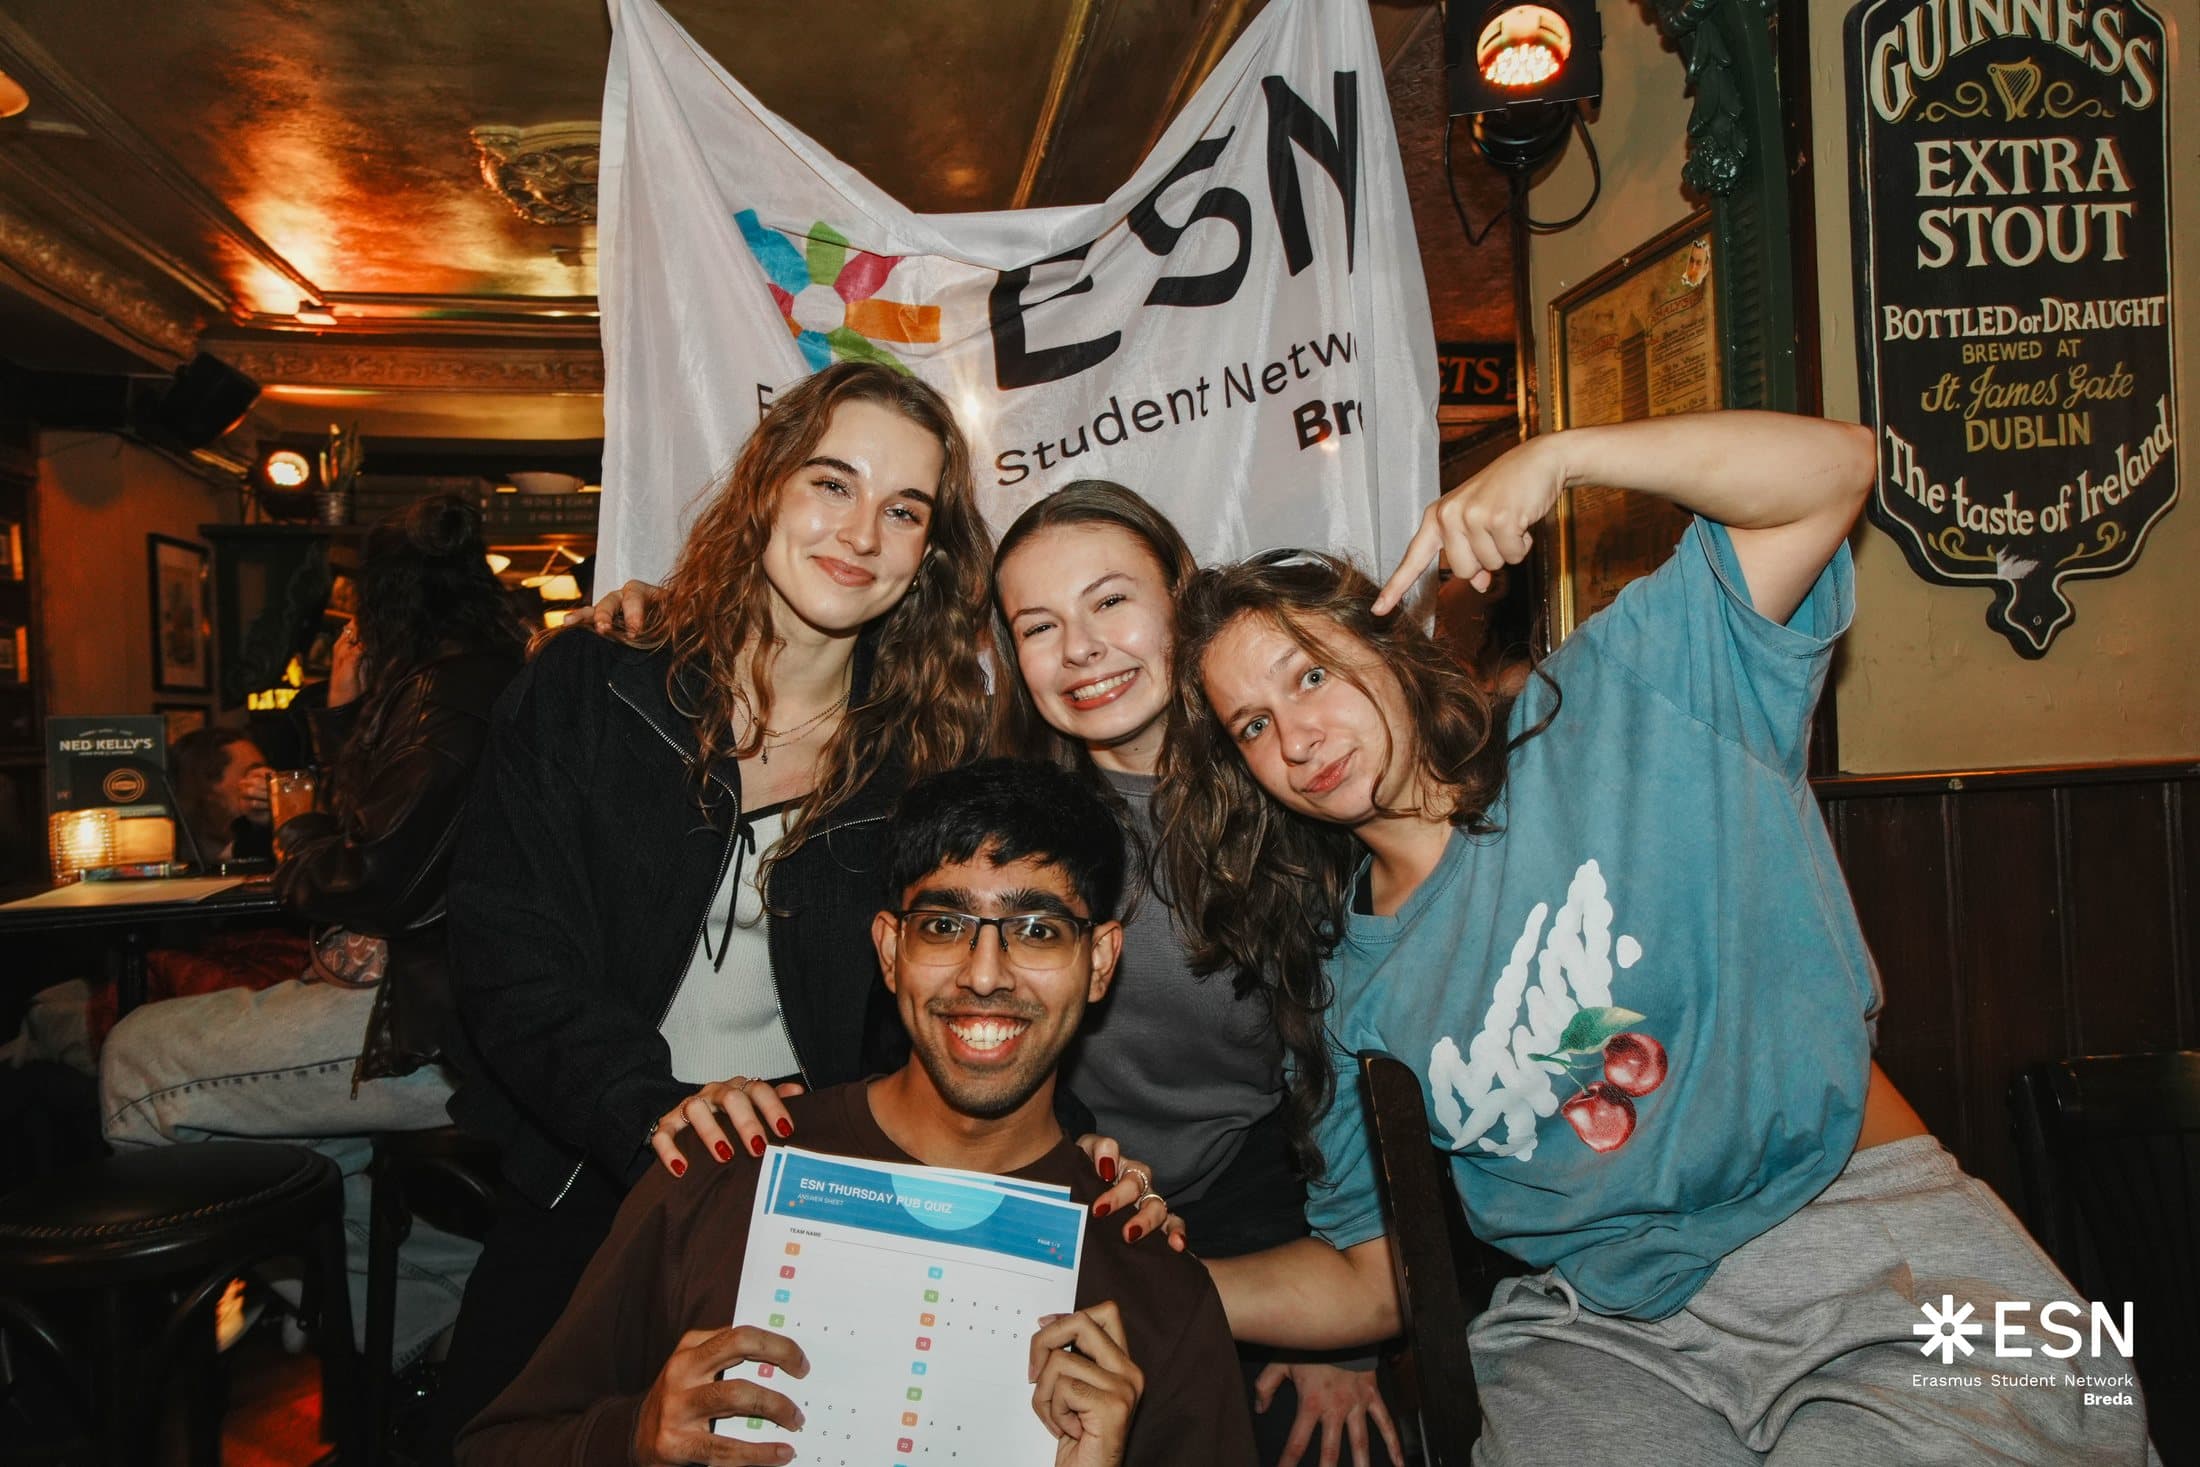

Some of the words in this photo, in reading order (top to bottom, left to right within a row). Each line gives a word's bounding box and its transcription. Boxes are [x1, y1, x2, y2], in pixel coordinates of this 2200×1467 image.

[1870, 0, 2155, 122] GUINNESS
[1914, 138, 2132, 197] EXTRA
[989, 70, 1359, 390] ESN
[1917, 203, 2132, 270] STOUT
[1883, 304, 2018, 341] BOTTLED
[2018, 313, 2043, 334] or
[2040, 296, 2166, 334] DRAUGHT
[1962, 341, 2043, 365] BREWED
[2056, 338, 2082, 359] AT
[996, 377, 1211, 487] Student
[1223, 332, 1359, 410] Netw
[1920, 371, 1961, 412] St.
[1963, 364, 2060, 420] James
[2063, 361, 2135, 409] Gate
[1293, 399, 1364, 451] Br
[1965, 412, 2093, 453] DUBLIN
[1885, 425, 1946, 515] The
[1951, 475, 2034, 536] taste
[2039, 484, 2072, 533] of
[2076, 393, 2173, 524] Ireland
[59, 740, 92, 752] NED
[96, 738, 153, 751] KELLY'S
[800, 1177, 827, 1192] ESN
[827, 1182, 895, 1205] THURSDAY
[895, 1193, 922, 1209] PUB
[924, 1201, 953, 1215] QUIZ
